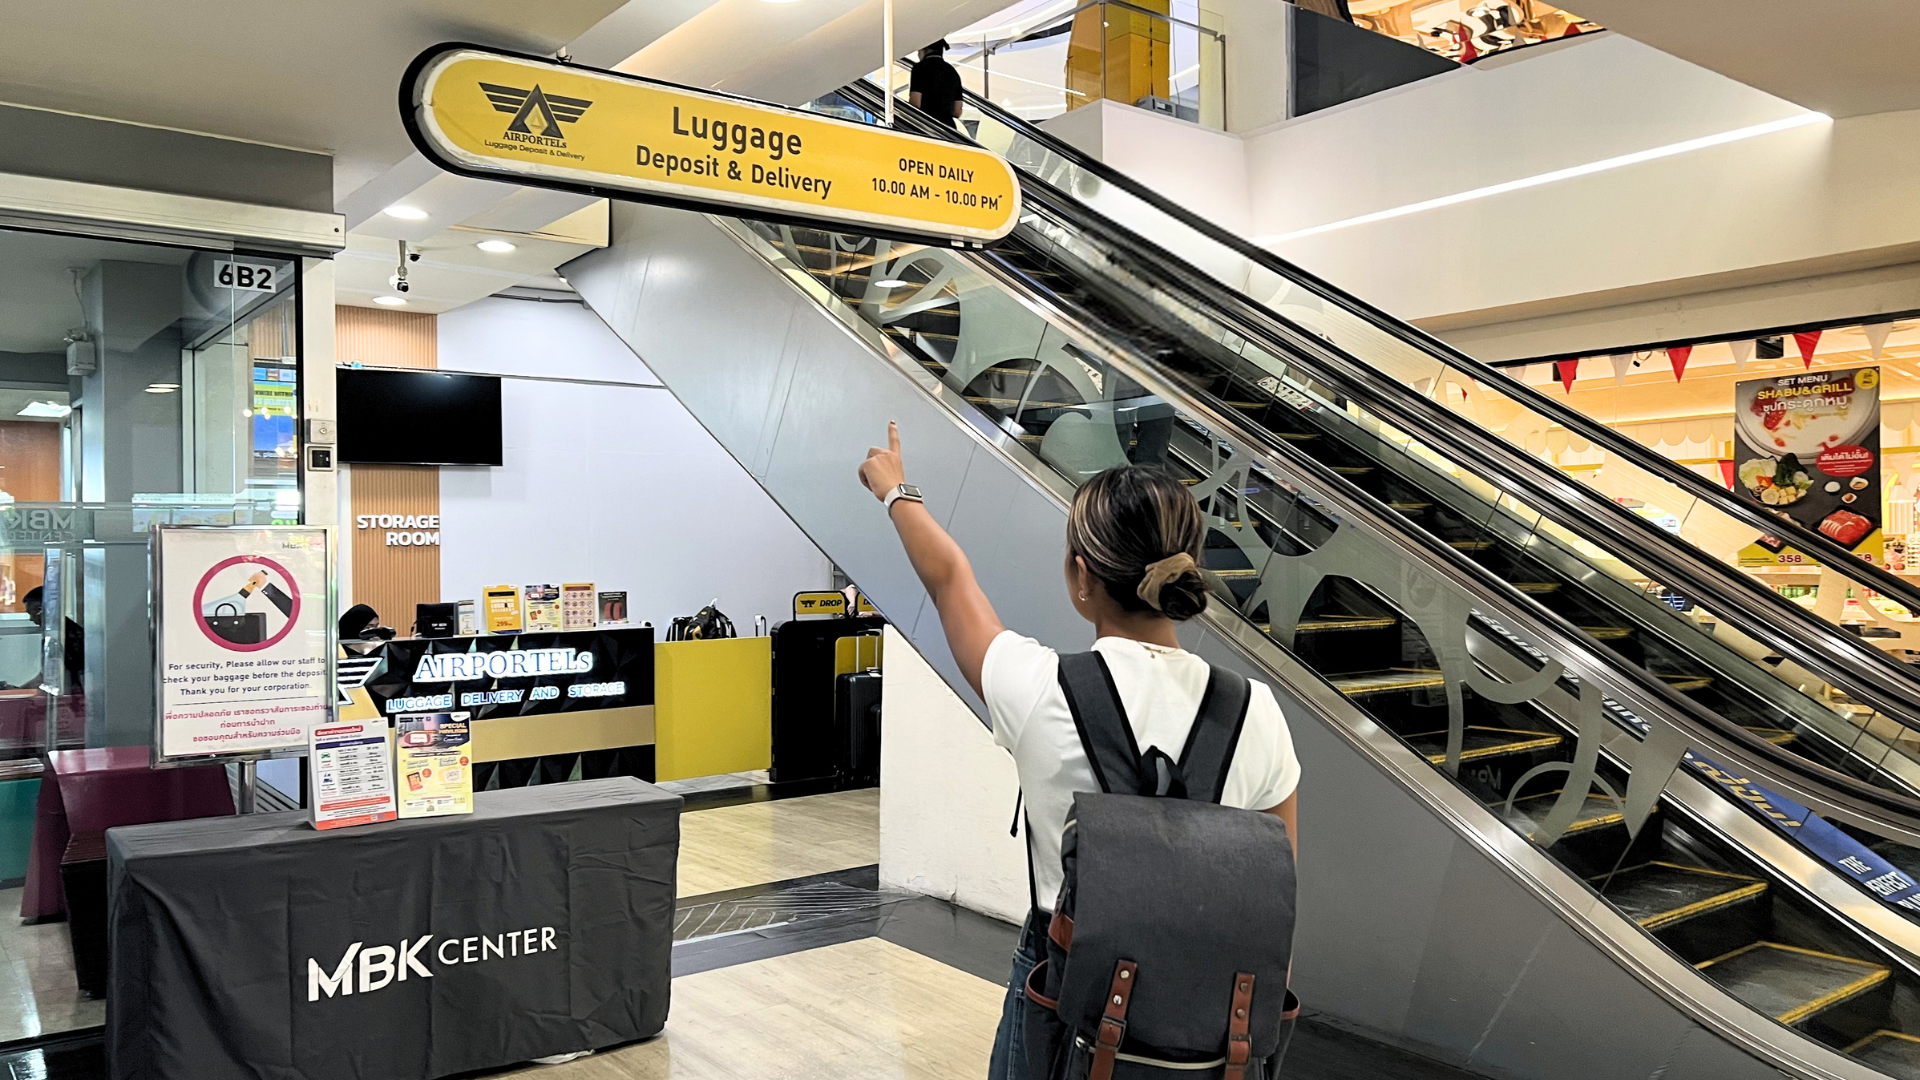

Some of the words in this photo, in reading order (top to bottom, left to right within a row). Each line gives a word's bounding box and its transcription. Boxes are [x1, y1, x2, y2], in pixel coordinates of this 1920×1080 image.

[673, 106, 802, 161] Luggage
[484, 139, 517, 151] Luggage
[519, 144, 548, 155] Deposit
[557, 150, 585, 161] Delivery
[636, 145, 719, 176] Deposit
[727, 160, 742, 181] &
[751, 163, 832, 200] Delivery
[899, 158, 934, 177] OPEN
[939, 165, 974, 183] DAILY
[872, 177, 905, 195] 10.00
[910, 184, 929, 199] AM
[946, 190, 976, 207] 10.00
[218, 264, 272, 290] 6B2
[1778, 377, 1796, 387] SET
[1797, 374, 1828, 385] MENU
[1757, 382, 1853, 400] SHABU&GRILL
[356, 514, 440, 529] STORAGE
[385, 531, 440, 546] ROOM
[1778, 554, 1802, 563] 358
[819, 599, 842, 607] DROP
[226, 660, 254, 668] Please
[256, 659, 279, 667] allow
[298, 657, 315, 665] staff
[163, 676, 188, 684] check
[191, 675, 210, 684] your
[213, 673, 250, 682] baggage
[252, 671, 278, 679] before
[281, 670, 294, 678] the
[297, 669, 326, 678] deposit
[180, 688, 207, 696] Thank
[209, 688, 225, 696] you
[242, 685, 260, 694] your
[387, 695, 452, 712] LUGGAGE
[461, 690, 524, 706] DELIVERY
[530, 686, 559, 700] AND
[568, 682, 625, 697] STORAGE
[164, 709, 231, 720] พื่อความปลอดภัย
[1838, 855, 1872, 875] THE
[308, 934, 434, 1002] MBK
[438, 926, 557, 965] CENTER
